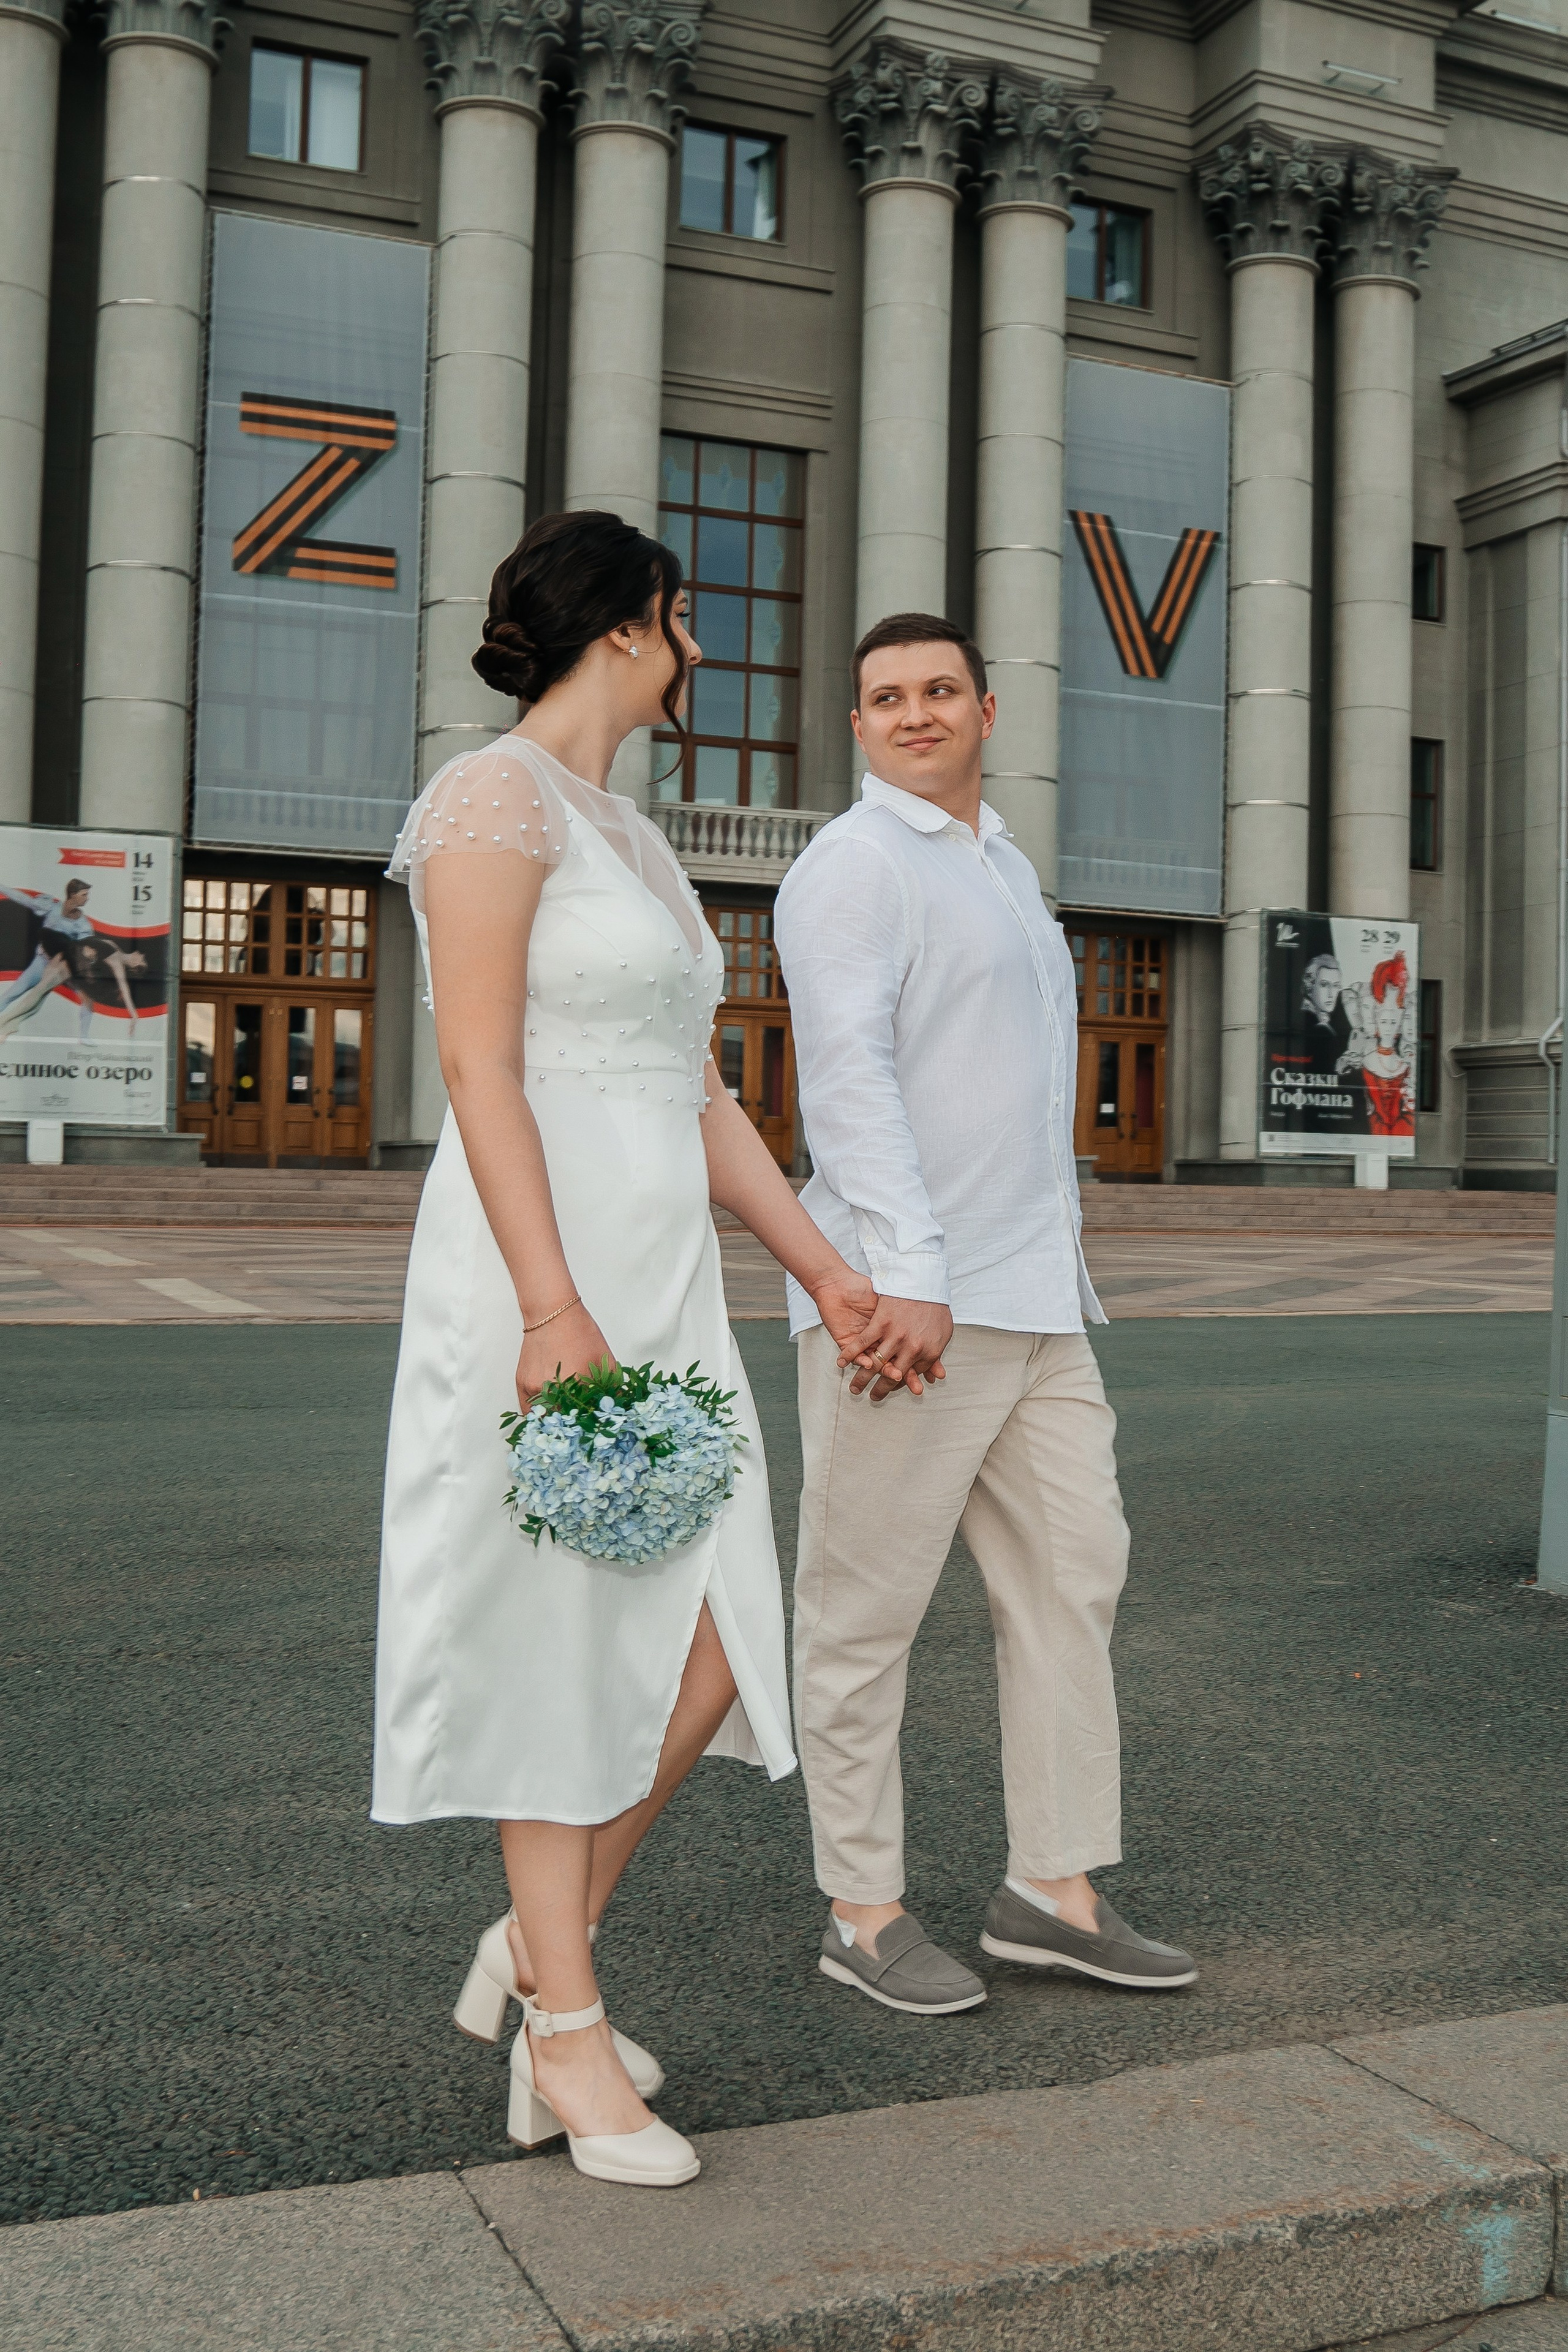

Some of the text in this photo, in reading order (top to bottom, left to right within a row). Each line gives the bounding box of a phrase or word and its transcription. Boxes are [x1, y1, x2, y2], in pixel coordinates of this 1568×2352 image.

[232, 391, 398, 589] Z
[1068, 508, 1223, 679] V
[132, 852, 154, 868] 14
[132, 885, 153, 901] 15
[86, 1065, 153, 1084] озеро
[1270, 1067, 1339, 1087] Сказки
[1270, 1087, 1354, 1109] Гофмана
